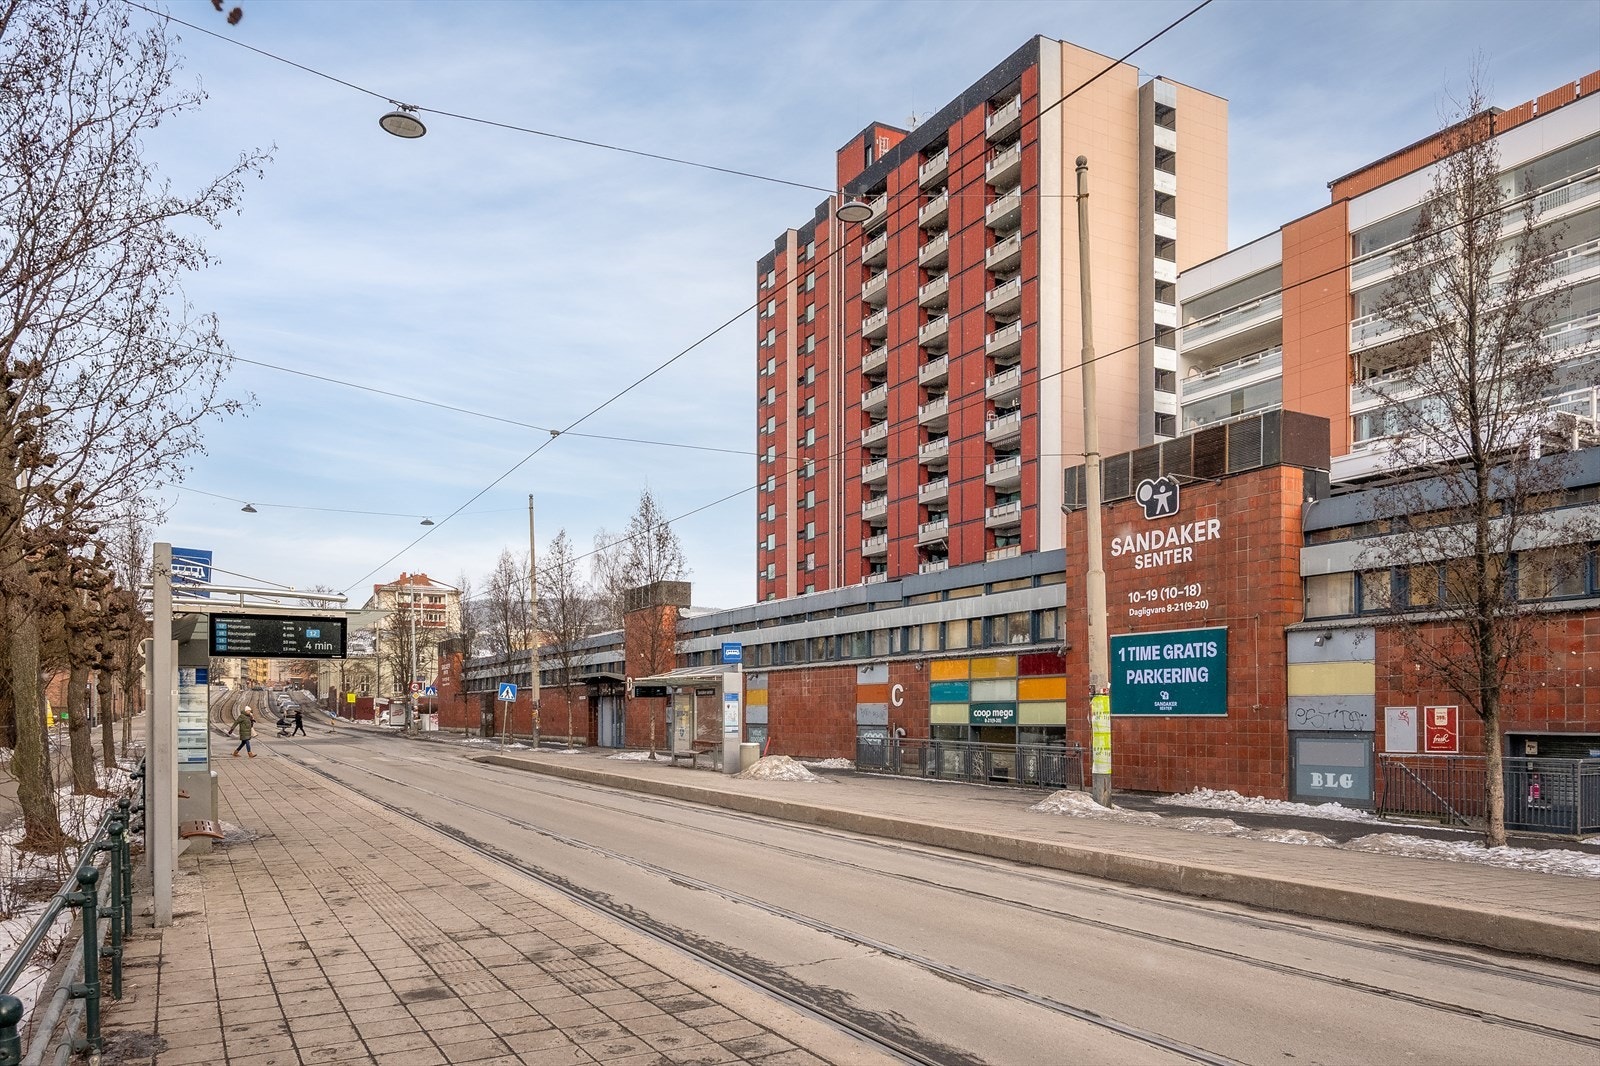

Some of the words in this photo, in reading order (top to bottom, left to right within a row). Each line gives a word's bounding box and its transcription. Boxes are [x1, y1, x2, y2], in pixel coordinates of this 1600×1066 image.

[1111, 518, 1221, 557] SANDAKER
[1134, 546, 1193, 570] SENTER
[1129, 606, 1166, 618] Dagligvare
[305, 641, 312, 650] 4
[314, 641, 333, 650] min
[1118, 647, 1126, 661] 1
[1128, 645, 1161, 661] TIME
[1163, 641, 1218, 660] GRATIS
[1126, 666, 1209, 684] PARKERING
[626, 677, 633, 692] D
[891, 684, 904, 707] C
[973, 709, 992, 718] coop
[992, 709, 1014, 719] mega
